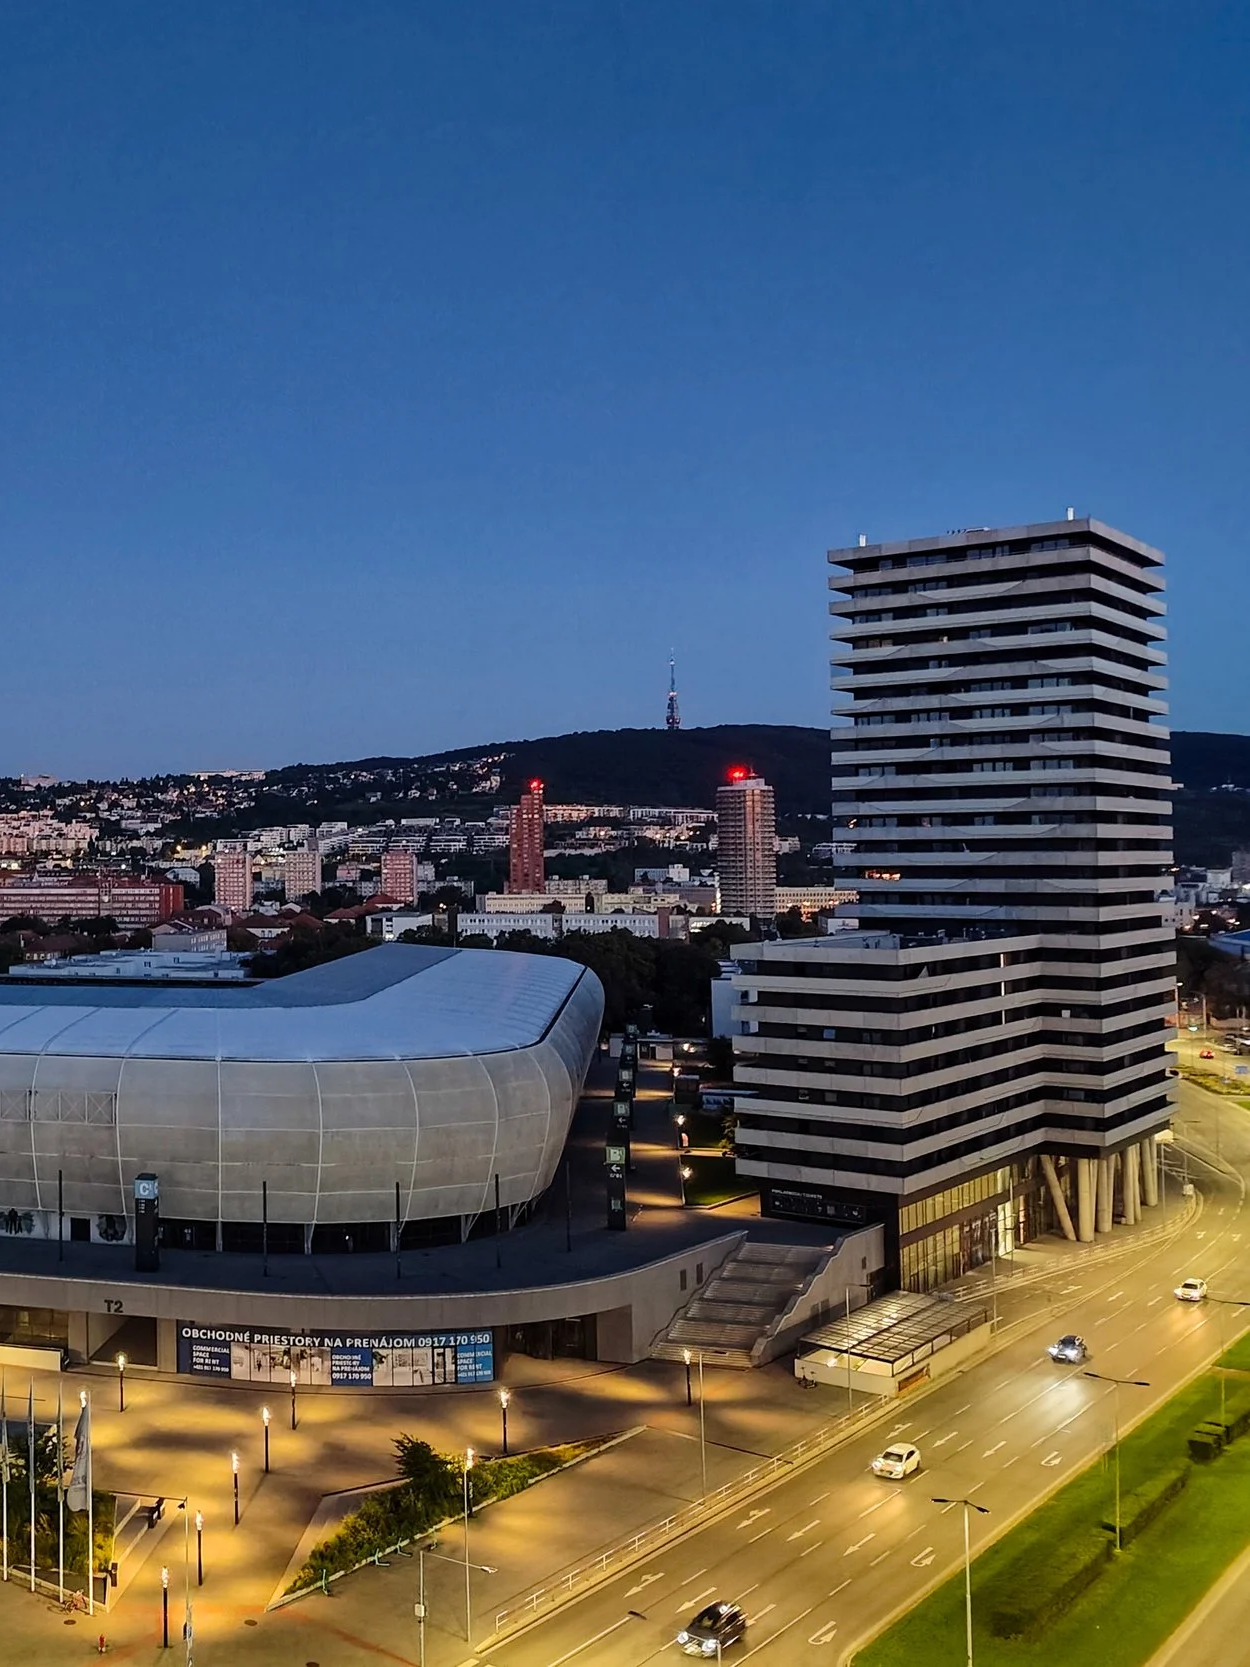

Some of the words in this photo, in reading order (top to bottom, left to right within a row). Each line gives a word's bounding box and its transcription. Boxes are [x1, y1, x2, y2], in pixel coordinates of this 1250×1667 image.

[104, 1299, 123, 1313] T2
[182, 1327, 250, 1343] OBCHODNÉ
[253, 1333, 321, 1348] PRIESTORY
[324, 1338, 343, 1349] NA
[346, 1336, 416, 1349] PRENÁJOM
[418, 1337, 446, 1347] 0917
[449, 1335, 468, 1346] 170
[470, 1334, 490, 1344] 950
